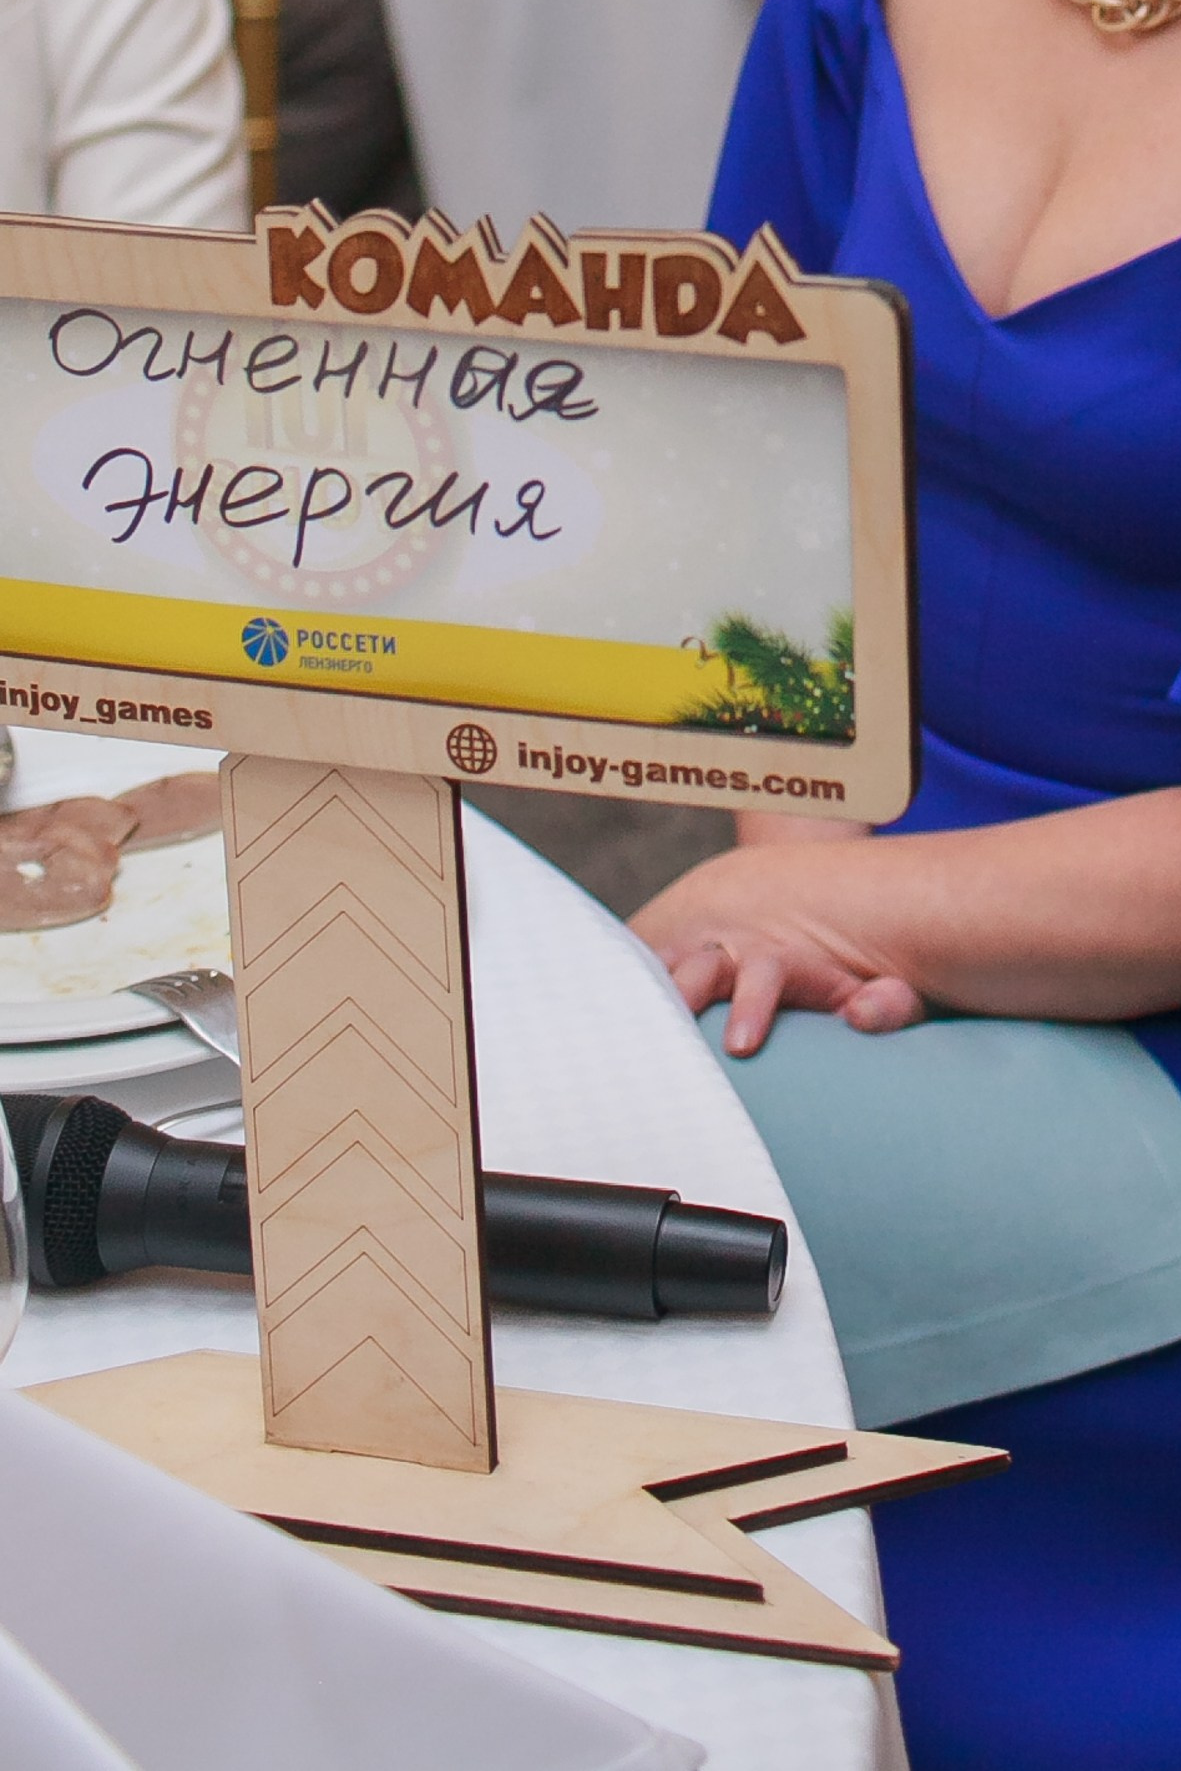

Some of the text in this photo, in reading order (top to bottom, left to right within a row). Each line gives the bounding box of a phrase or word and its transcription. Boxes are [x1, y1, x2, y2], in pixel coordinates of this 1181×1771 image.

[268, 226, 807, 346] КОМАНДА
[82, 448, 563, 568] Энергия
[297, 629, 397, 655] РОССЕТИ
[299, 656, 373, 674] ЛЕНЭНЕРГО
[0, 680, 213, 729] injoy_games
[518, 741, 846, 801] injoy-games.com
